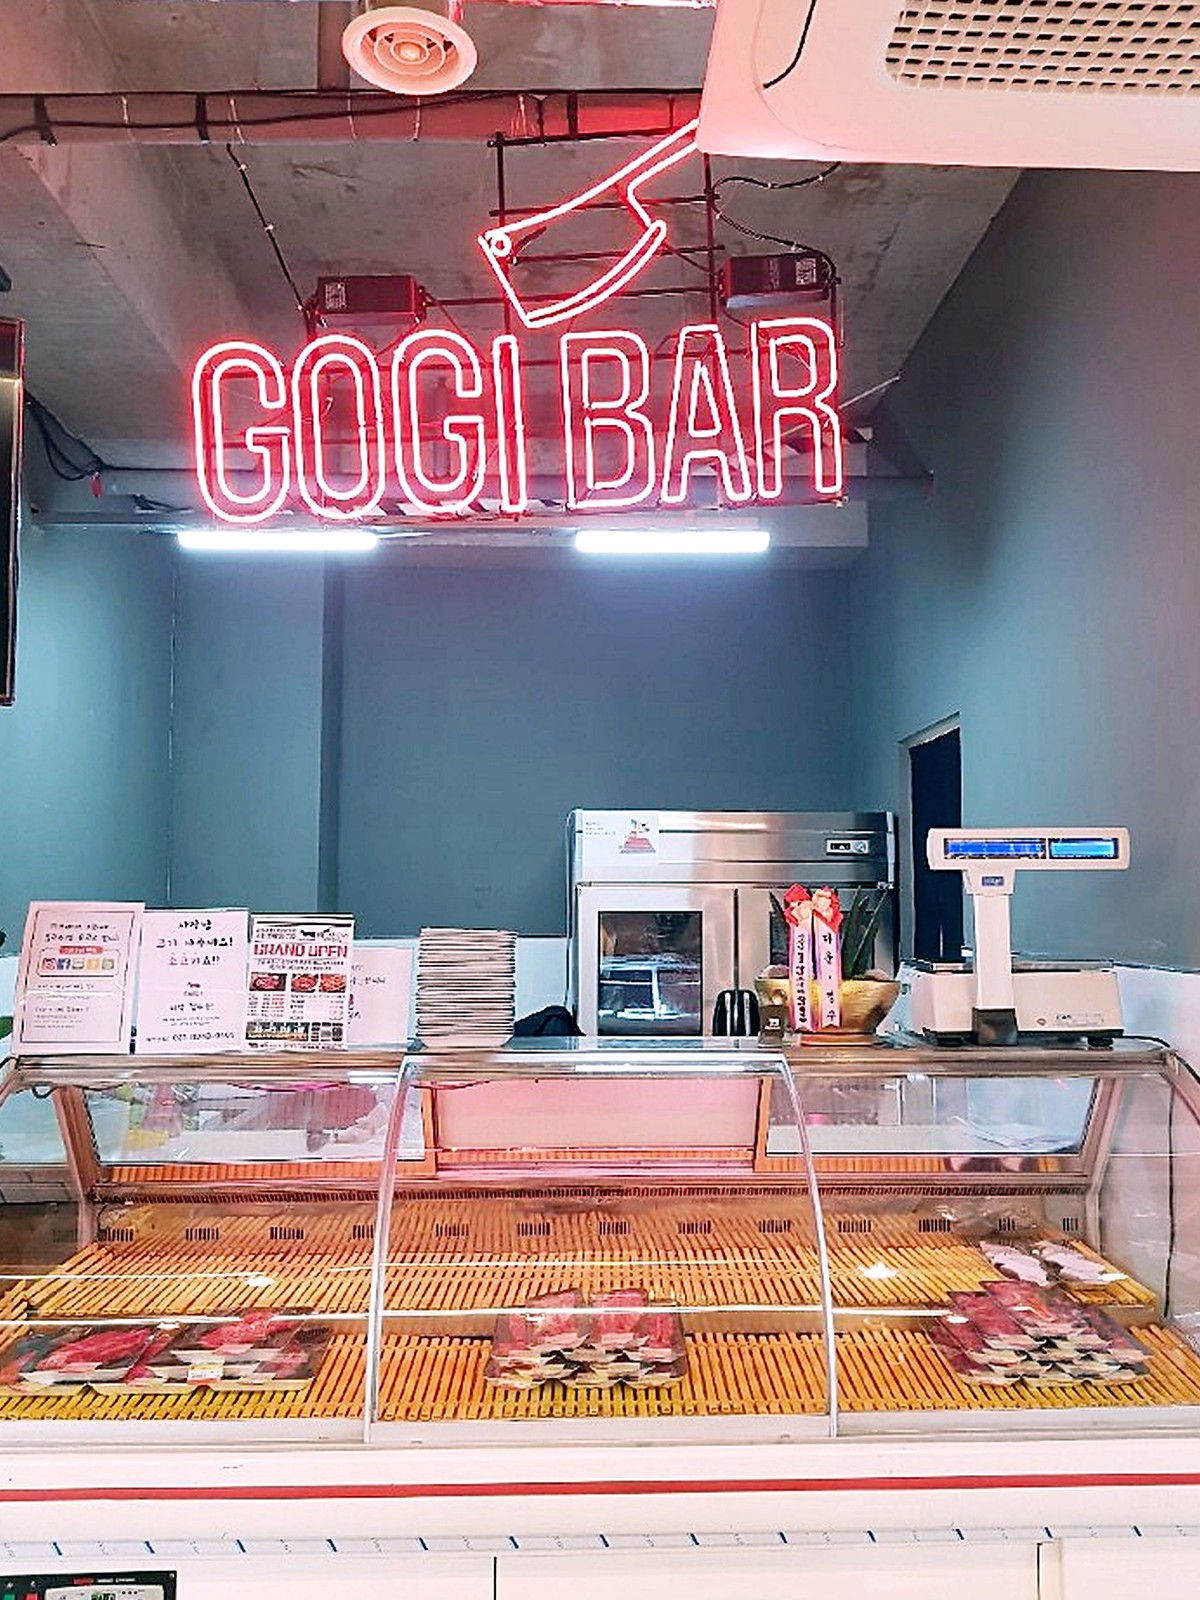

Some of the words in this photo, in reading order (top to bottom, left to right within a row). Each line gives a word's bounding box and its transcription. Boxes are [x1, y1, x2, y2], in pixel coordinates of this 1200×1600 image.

[192, 329, 527, 523] GOGI
[560, 317, 843, 511] BAR
[253, 943, 306, 958] GRAND
